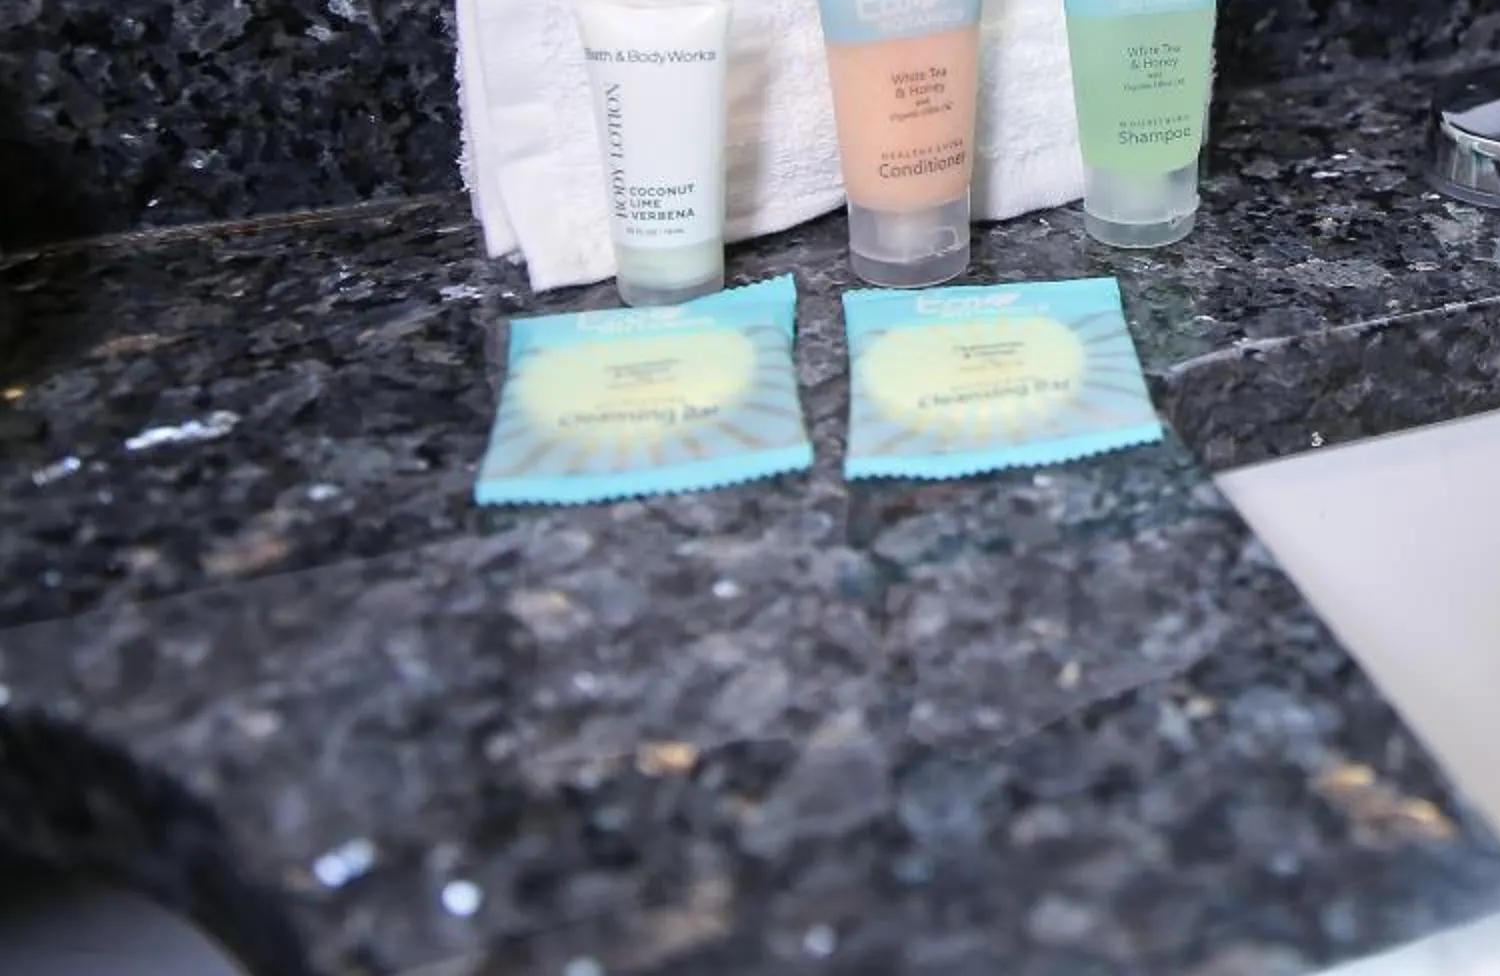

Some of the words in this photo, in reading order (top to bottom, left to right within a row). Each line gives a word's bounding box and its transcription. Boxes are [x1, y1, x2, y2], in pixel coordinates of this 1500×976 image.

[615, 50, 625, 63] &
[627, 50, 665, 65] Body
[667, 50, 717, 62] Works
[1118, 127, 1192, 145] Shampoo
[879, 150, 966, 178] Conditioner
[629, 183, 694, 197] COCONUT
[629, 199, 662, 209] LIME
[631, 207, 695, 221] VERBENA
